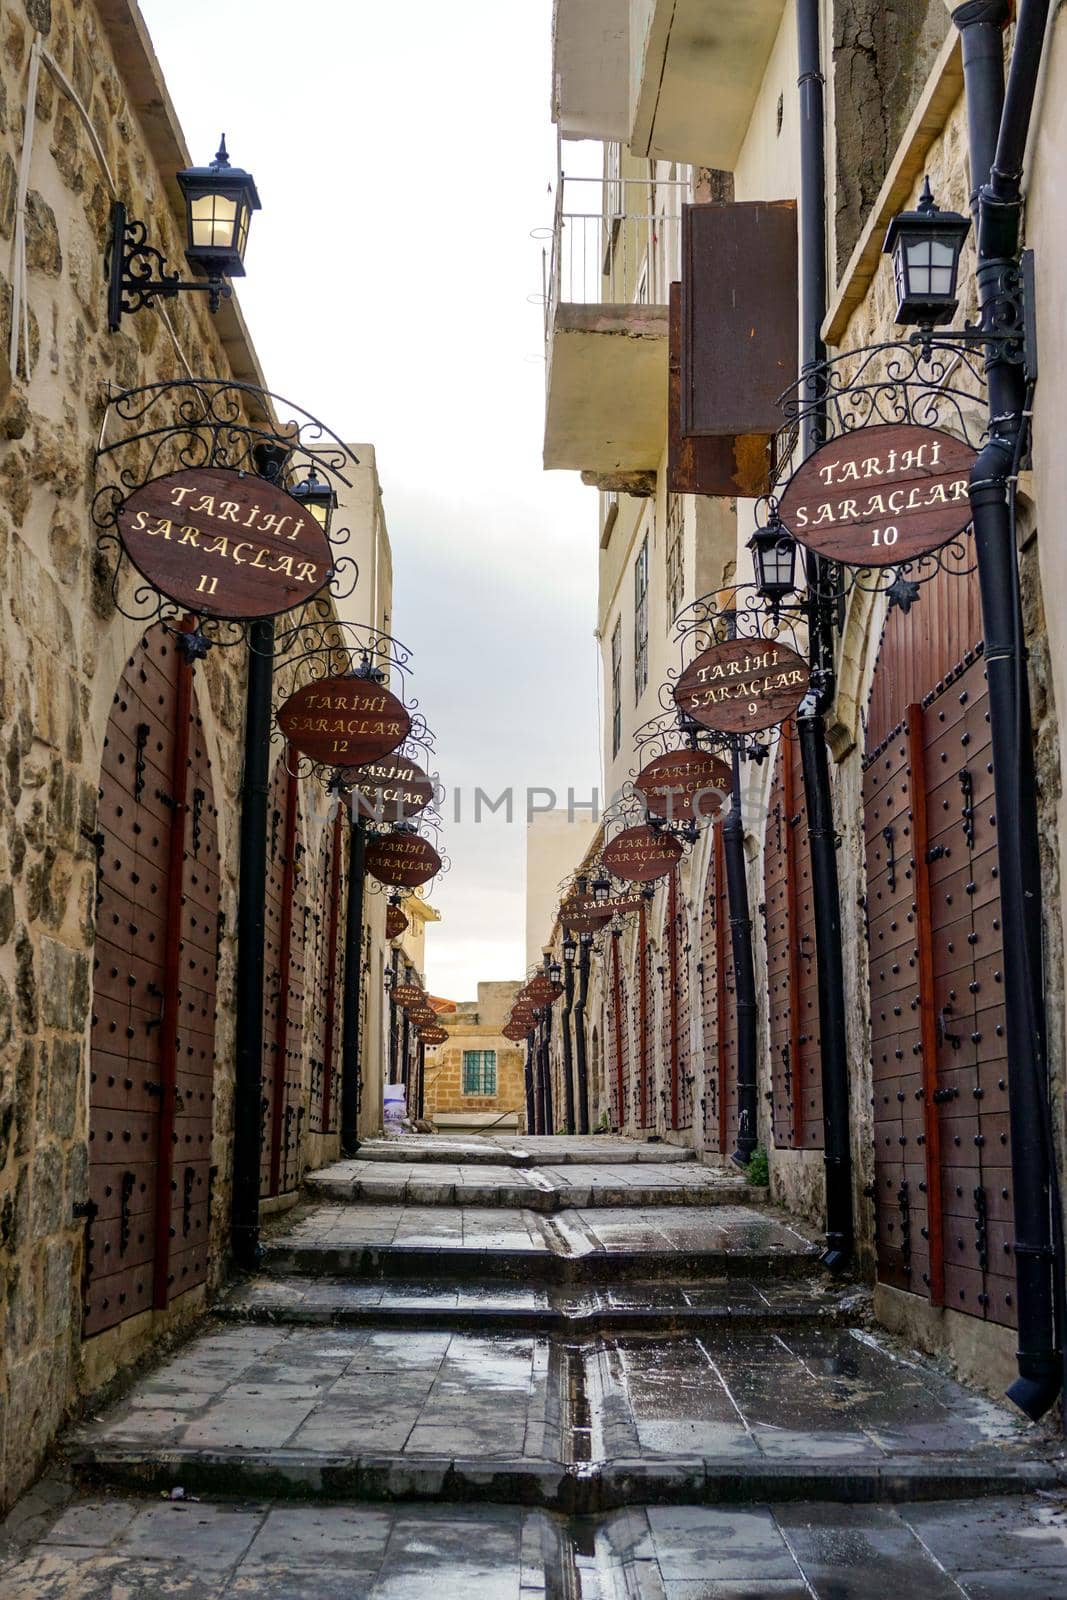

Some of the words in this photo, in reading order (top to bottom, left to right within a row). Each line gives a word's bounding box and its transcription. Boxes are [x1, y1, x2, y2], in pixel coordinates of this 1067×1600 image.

[819, 441, 942, 486] TARİHİ
[170, 487, 305, 541] TARİHİ
[796, 480, 970, 527] SARAÇLAR
[871, 526, 898, 547] 10
[131, 511, 318, 584] SARAÇLAR
[195, 574, 219, 595] 11
[696, 649, 780, 684] TARİHİ
[690, 670, 804, 708] SARAÇLAR
[304, 694, 389, 713] TARİHİ
[747, 702, 758, 716] 9
[289, 716, 401, 736] SARAÇLAR
[332, 740, 349, 752] 12
[683, 797, 690, 808] 8
[606, 849, 677, 863] SARAÇLAR
